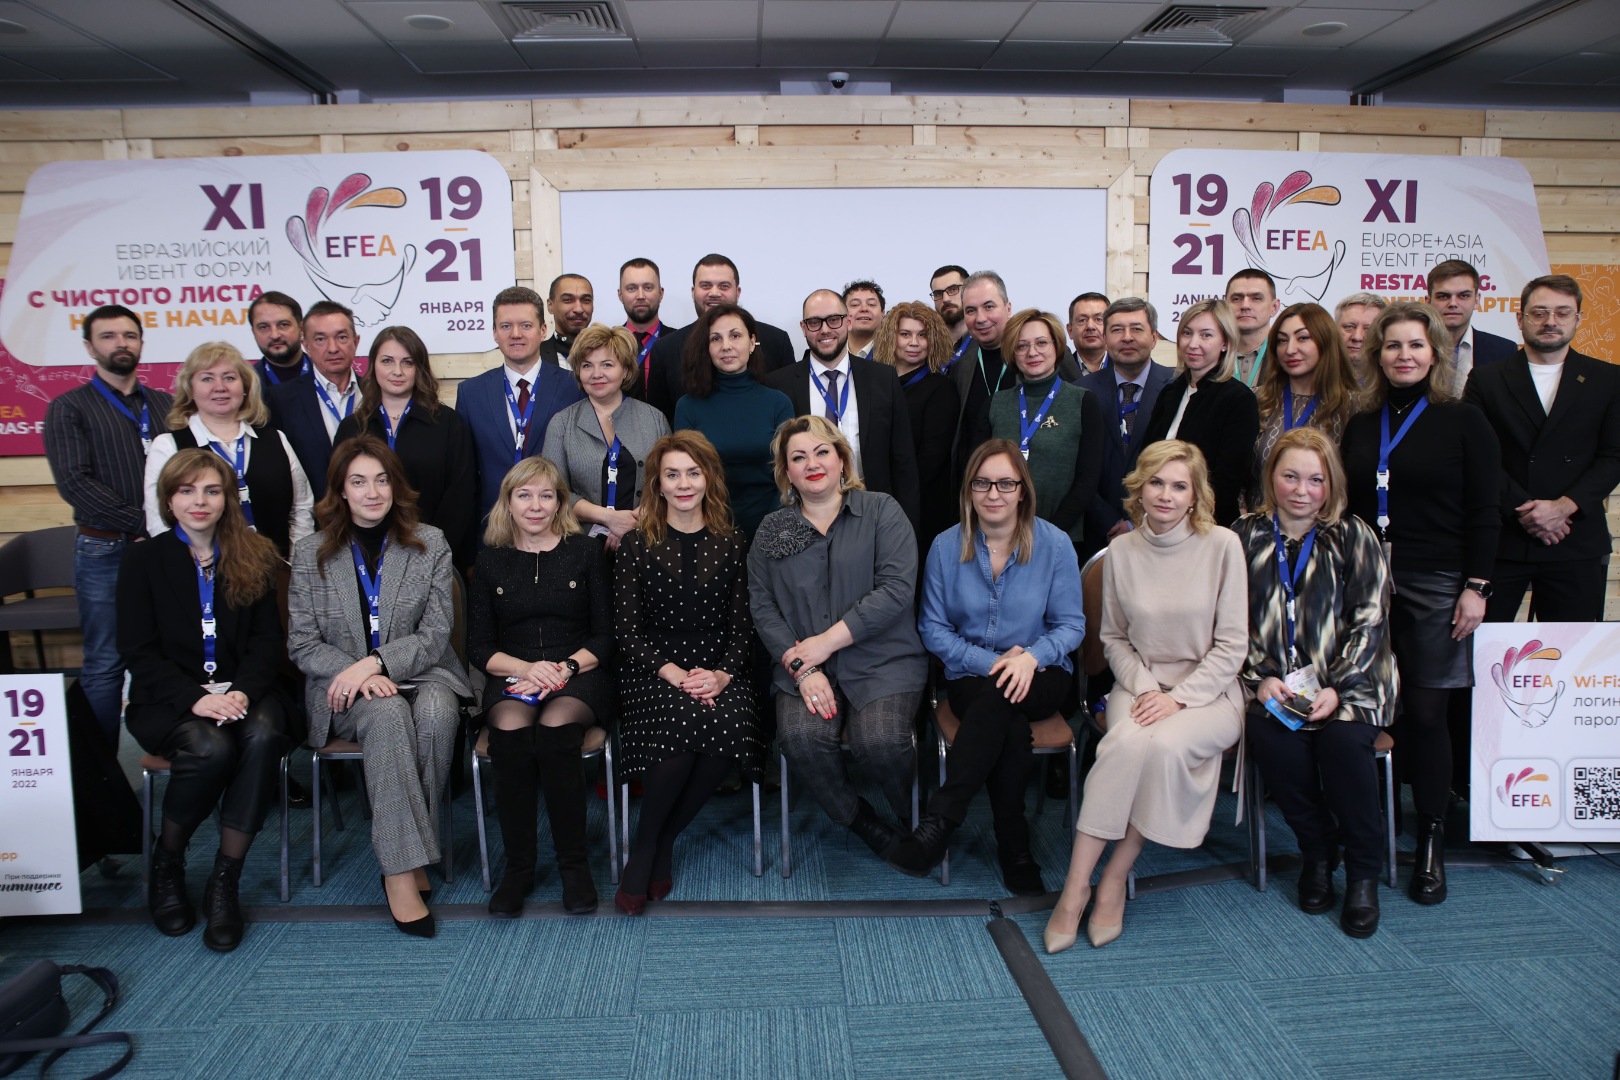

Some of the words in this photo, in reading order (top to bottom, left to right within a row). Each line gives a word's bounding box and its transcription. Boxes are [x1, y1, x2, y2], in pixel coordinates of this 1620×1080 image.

[419, 176, 483, 220] 19
[1172, 173, 1228, 216] 19
[1362, 179, 1418, 223] XI
[198, 183, 265, 231] XI
[115, 237, 271, 260] ЕВРАЗИЙСКИЙ
[325, 235, 397, 258] EFEA
[1266, 229, 1328, 251] EFEA
[1361, 232, 1484, 249] EUROPE+ASIA
[425, 238, 482, 282] 21
[1172, 233, 1224, 275] 21
[1361, 252, 1419, 267] EVENT
[118, 263, 186, 281] ИВЕНТ
[194, 261, 272, 279] ФОРУМ
[1360, 274, 1497, 291] RESTAG.
[28, 290, 45, 308] С
[51, 287, 172, 307] ЧИСТОГО
[179, 284, 264, 304] ЛИСТА
[165, 308, 249, 328] НАЧАЛ
[419, 301, 484, 314] ЯНВАРЯ
[447, 319, 485, 331] 2022
[1513, 675, 1553, 688] EFEA
[4, 689, 44, 717] 19
[8, 728, 46, 756] 21
[11, 768, 53, 777] ЯНВАРЯ
[12, 780, 37, 788] 2022
[1512, 794, 1552, 807] EFEA
